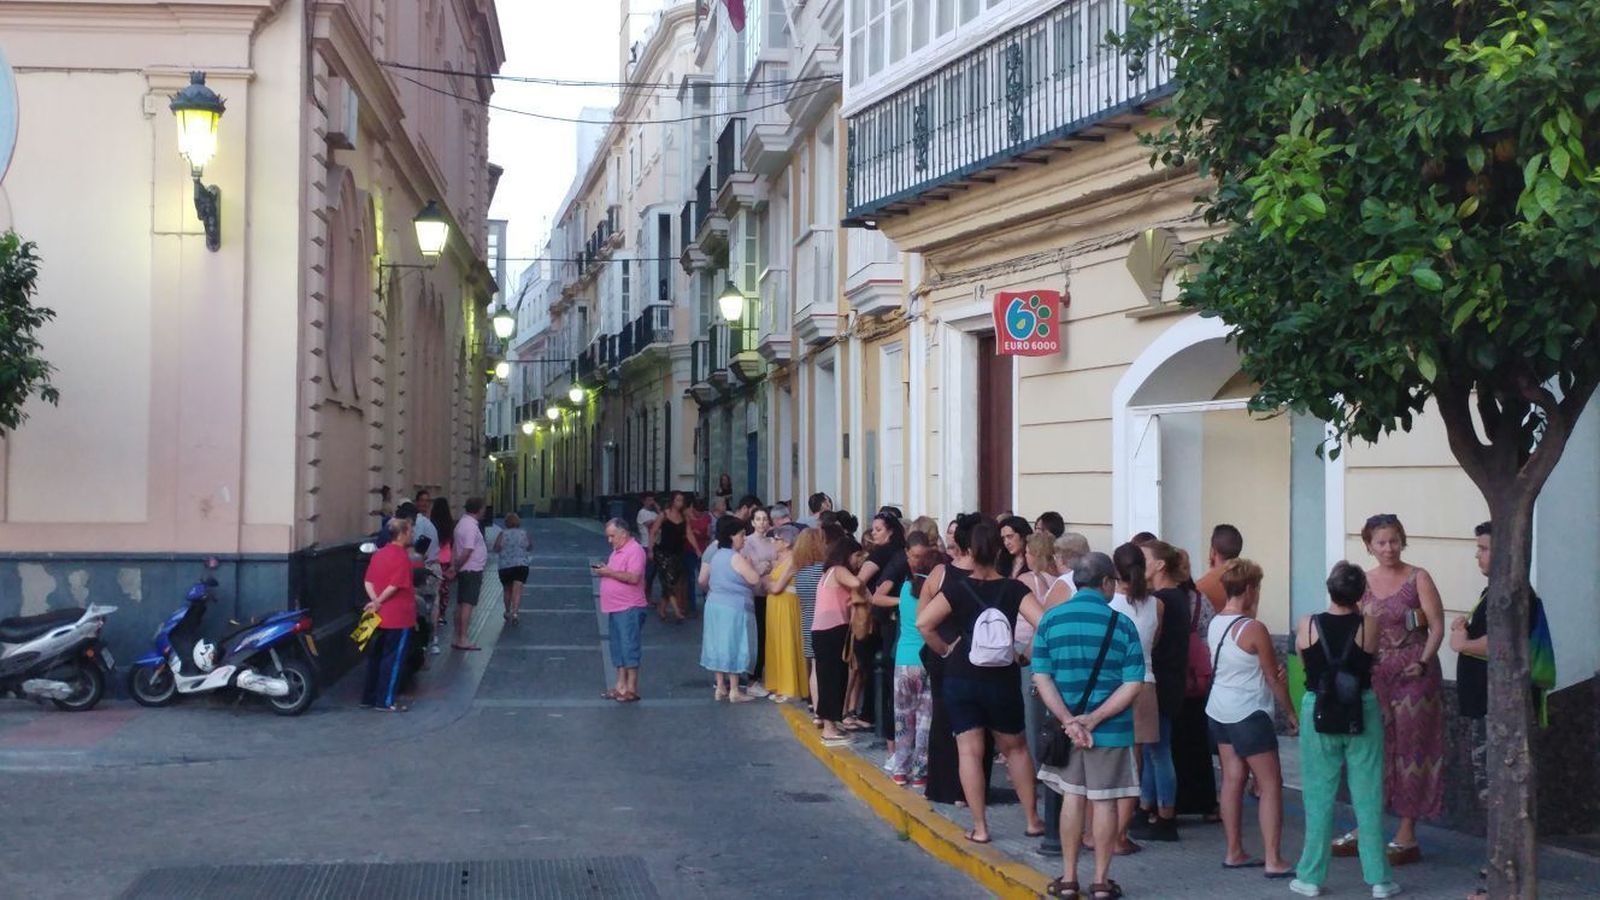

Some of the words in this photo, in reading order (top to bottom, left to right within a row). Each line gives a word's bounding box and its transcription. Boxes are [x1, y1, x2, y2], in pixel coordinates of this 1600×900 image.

[1005, 297, 1037, 340] 6
[1004, 341, 1030, 350] EURO
[1031, 341, 1057, 350] 6000
